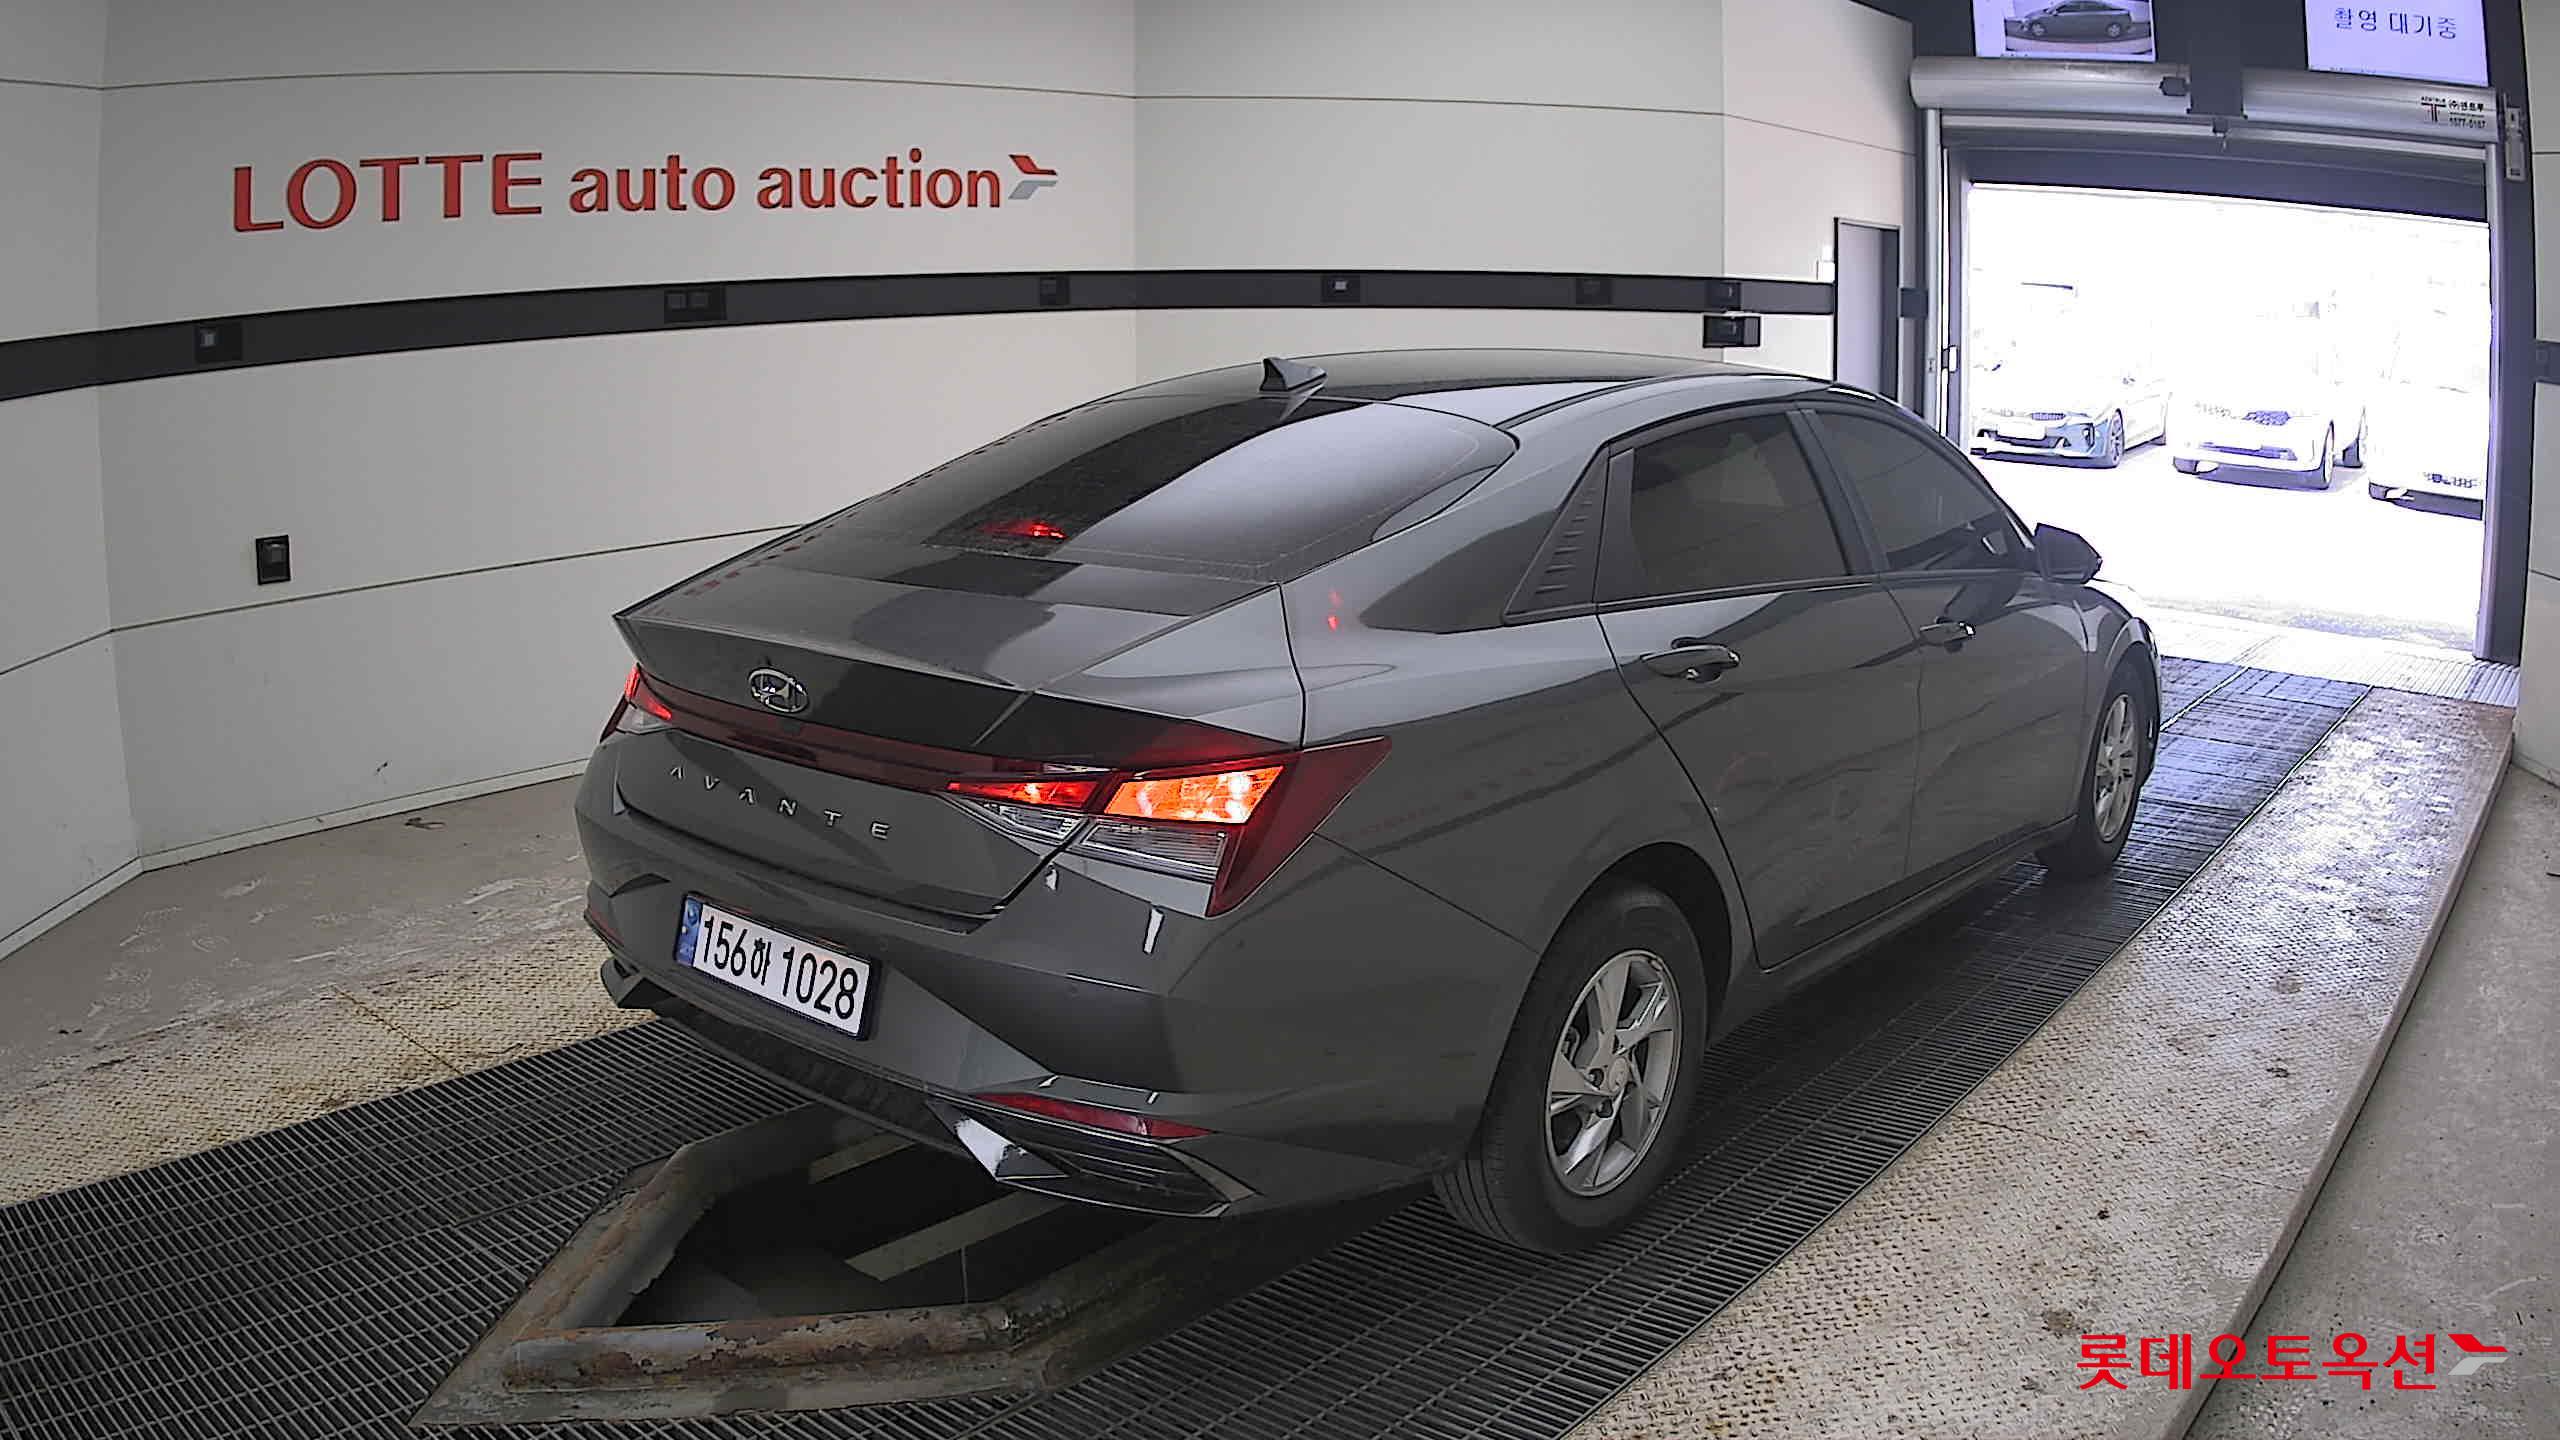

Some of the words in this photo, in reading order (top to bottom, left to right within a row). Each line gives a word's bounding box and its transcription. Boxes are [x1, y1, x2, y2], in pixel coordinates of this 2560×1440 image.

[2335, 8, 2377, 31] 촬영
[2389, 13, 2457, 40] 대기중
[233, 151, 543, 232] LOTTE
[569, 154, 736, 214] auto
[757, 147, 1002, 209] auction
[670, 766, 890, 840] AVANTE
[703, 915, 772, 986] 156하
[782, 946, 859, 1020] 1028
